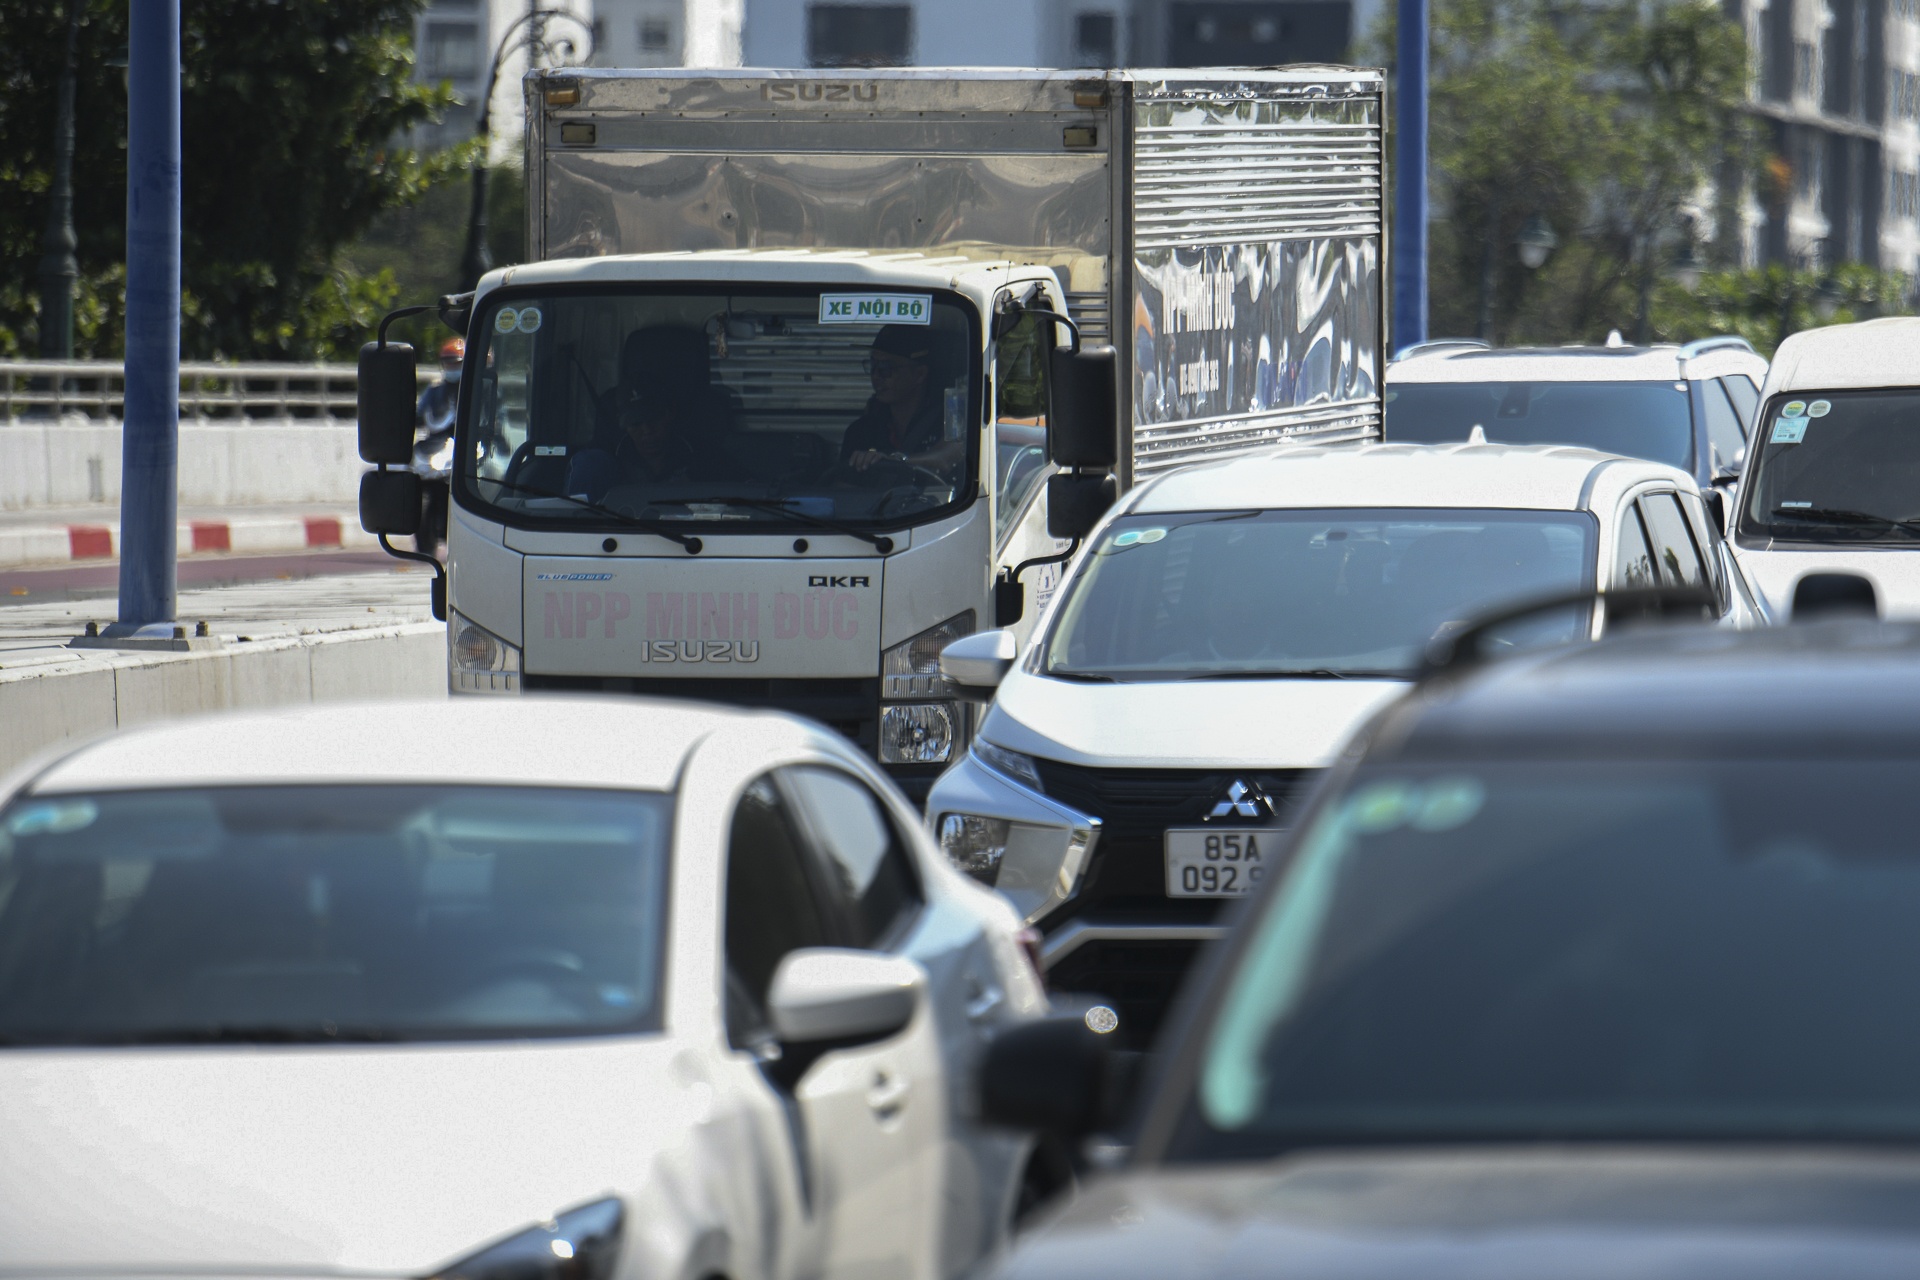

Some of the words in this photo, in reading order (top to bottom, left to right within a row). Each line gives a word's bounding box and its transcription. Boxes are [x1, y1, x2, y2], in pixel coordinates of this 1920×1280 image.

[760, 83, 877, 102] ISUZU
[828, 301, 852, 316] XE
[858, 298, 892, 318] NỘI
[896, 299, 923, 319] BỘ
[808, 575, 870, 588] QKR
[543, 592, 631, 640] NPP
[645, 592, 760, 640] MINH
[772, 586, 860, 641] ĐỨC
[640, 640, 760, 664] ISUZU
[1204, 835, 1261, 862] 85A
[1182, 866, 1266, 893] 092.9
